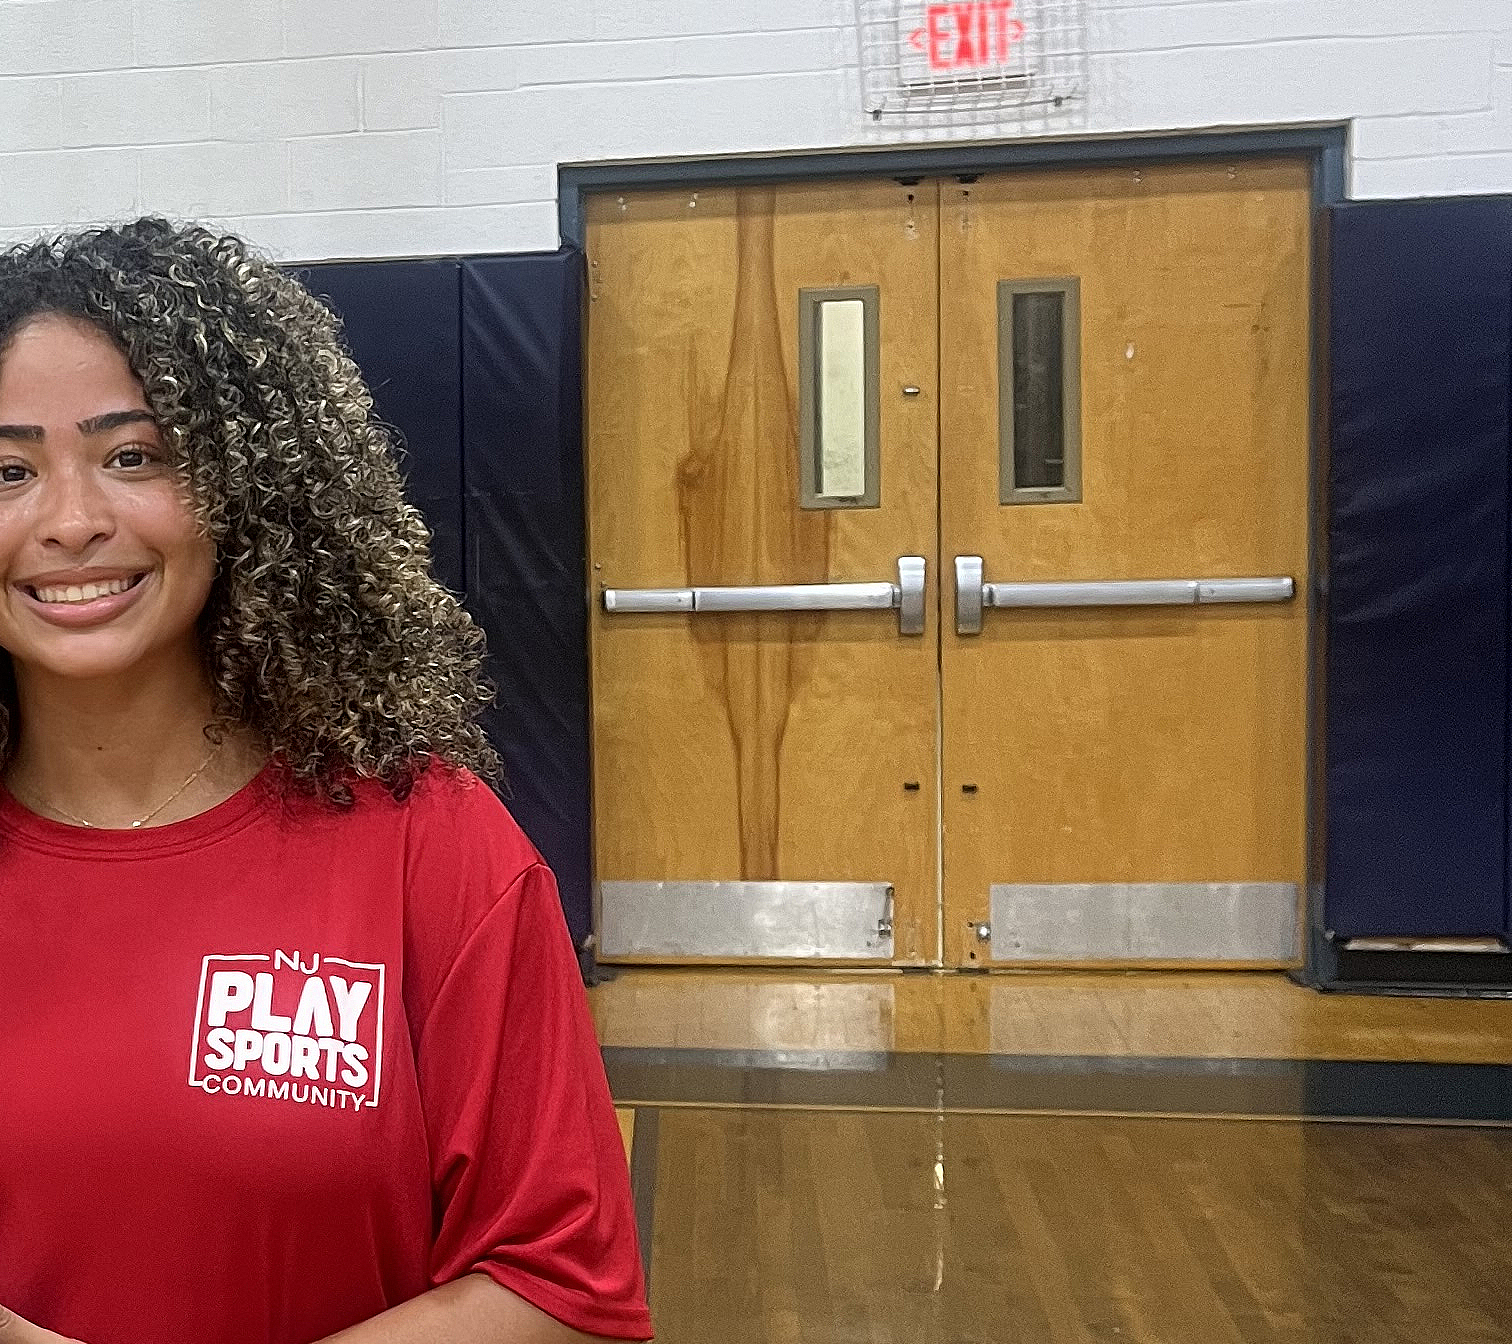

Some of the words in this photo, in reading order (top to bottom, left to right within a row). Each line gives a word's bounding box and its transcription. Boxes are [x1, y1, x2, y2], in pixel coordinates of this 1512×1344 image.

[274, 948, 320, 974] NJ
[207, 970, 373, 1042] PLAY
[204, 1027, 369, 1088] SPORTS
[202, 1074, 366, 1111] COMMUNITY
